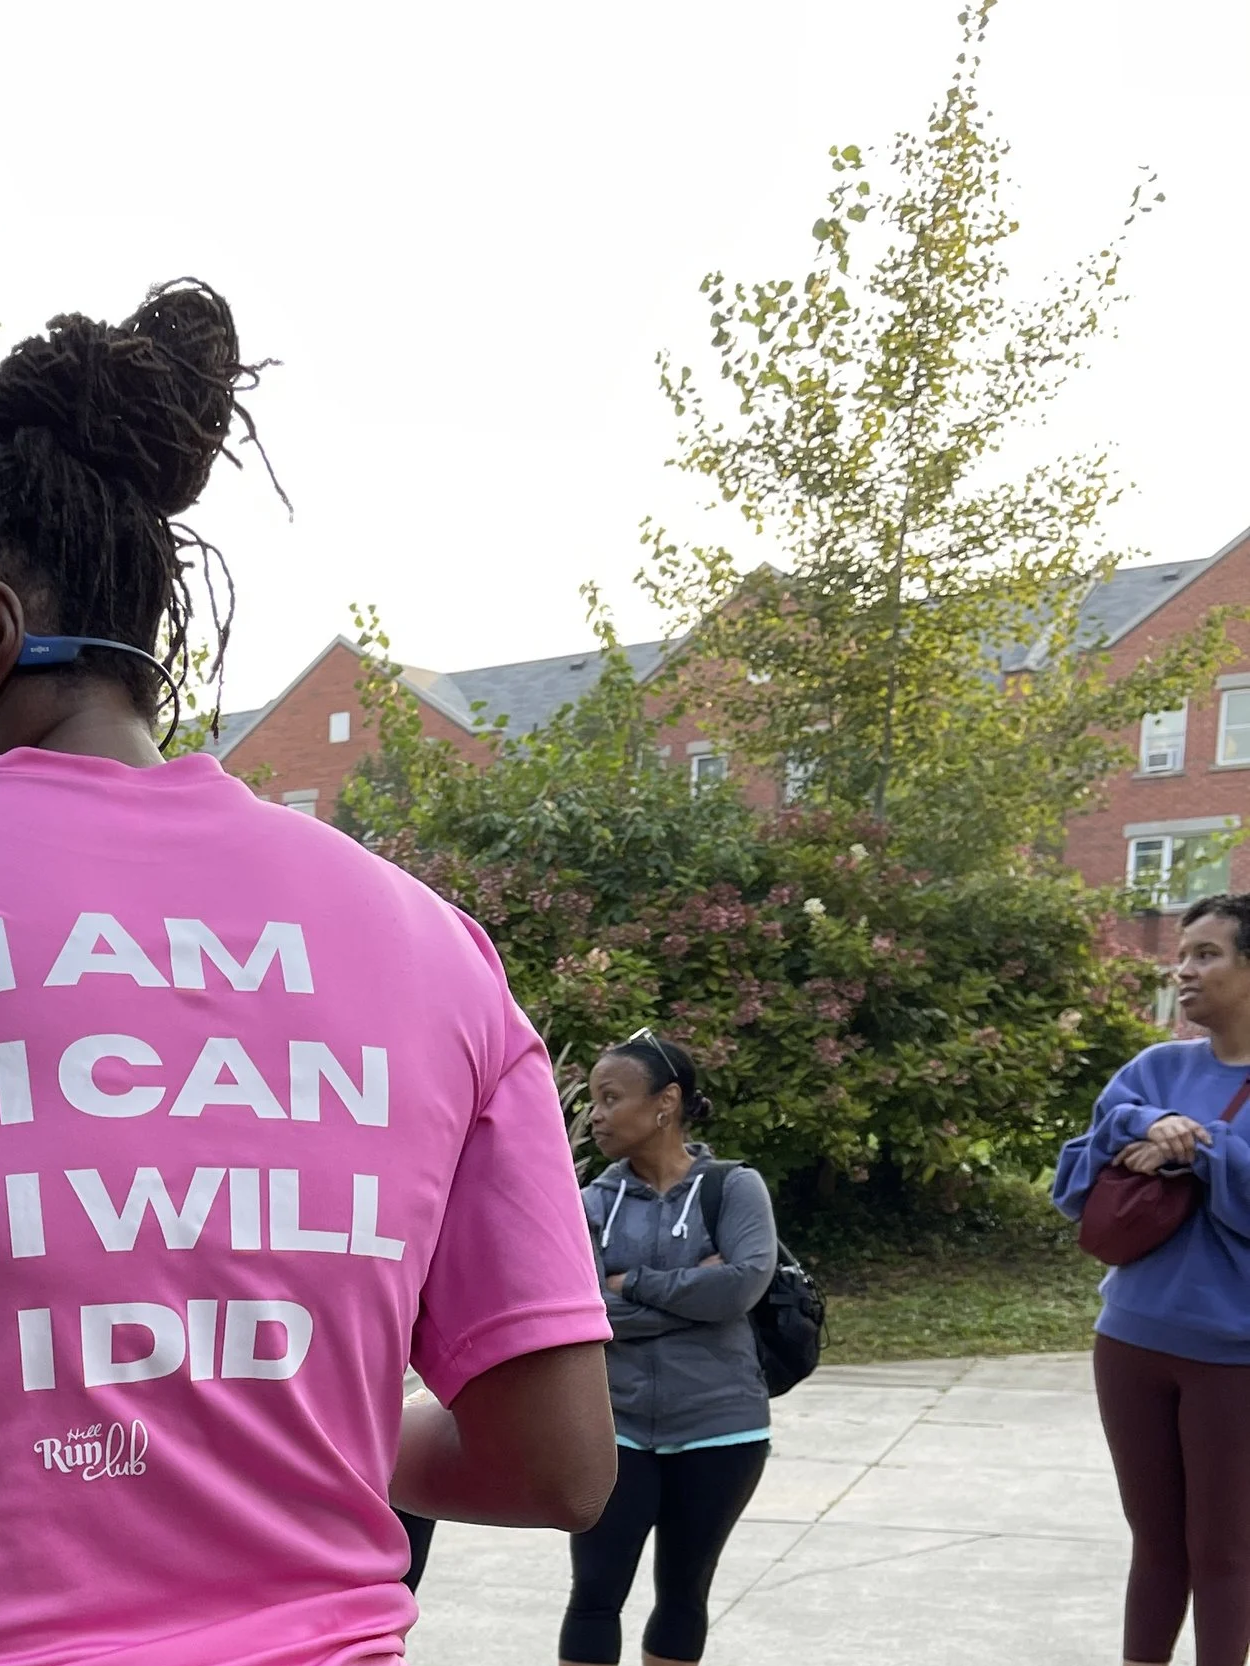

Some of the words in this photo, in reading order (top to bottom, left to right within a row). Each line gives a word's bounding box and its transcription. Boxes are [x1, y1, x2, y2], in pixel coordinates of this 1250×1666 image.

[43, 912, 314, 994] AM
[58, 1034, 388, 1127] CAN
[5, 1173, 46, 1258] I
[64, 1167, 406, 1261] WILL
[17, 1308, 55, 1391] I
[80, 1299, 313, 1388] DID
[34, 1438, 102, 1473] Run
[67, 1423, 102, 1442] Hill
